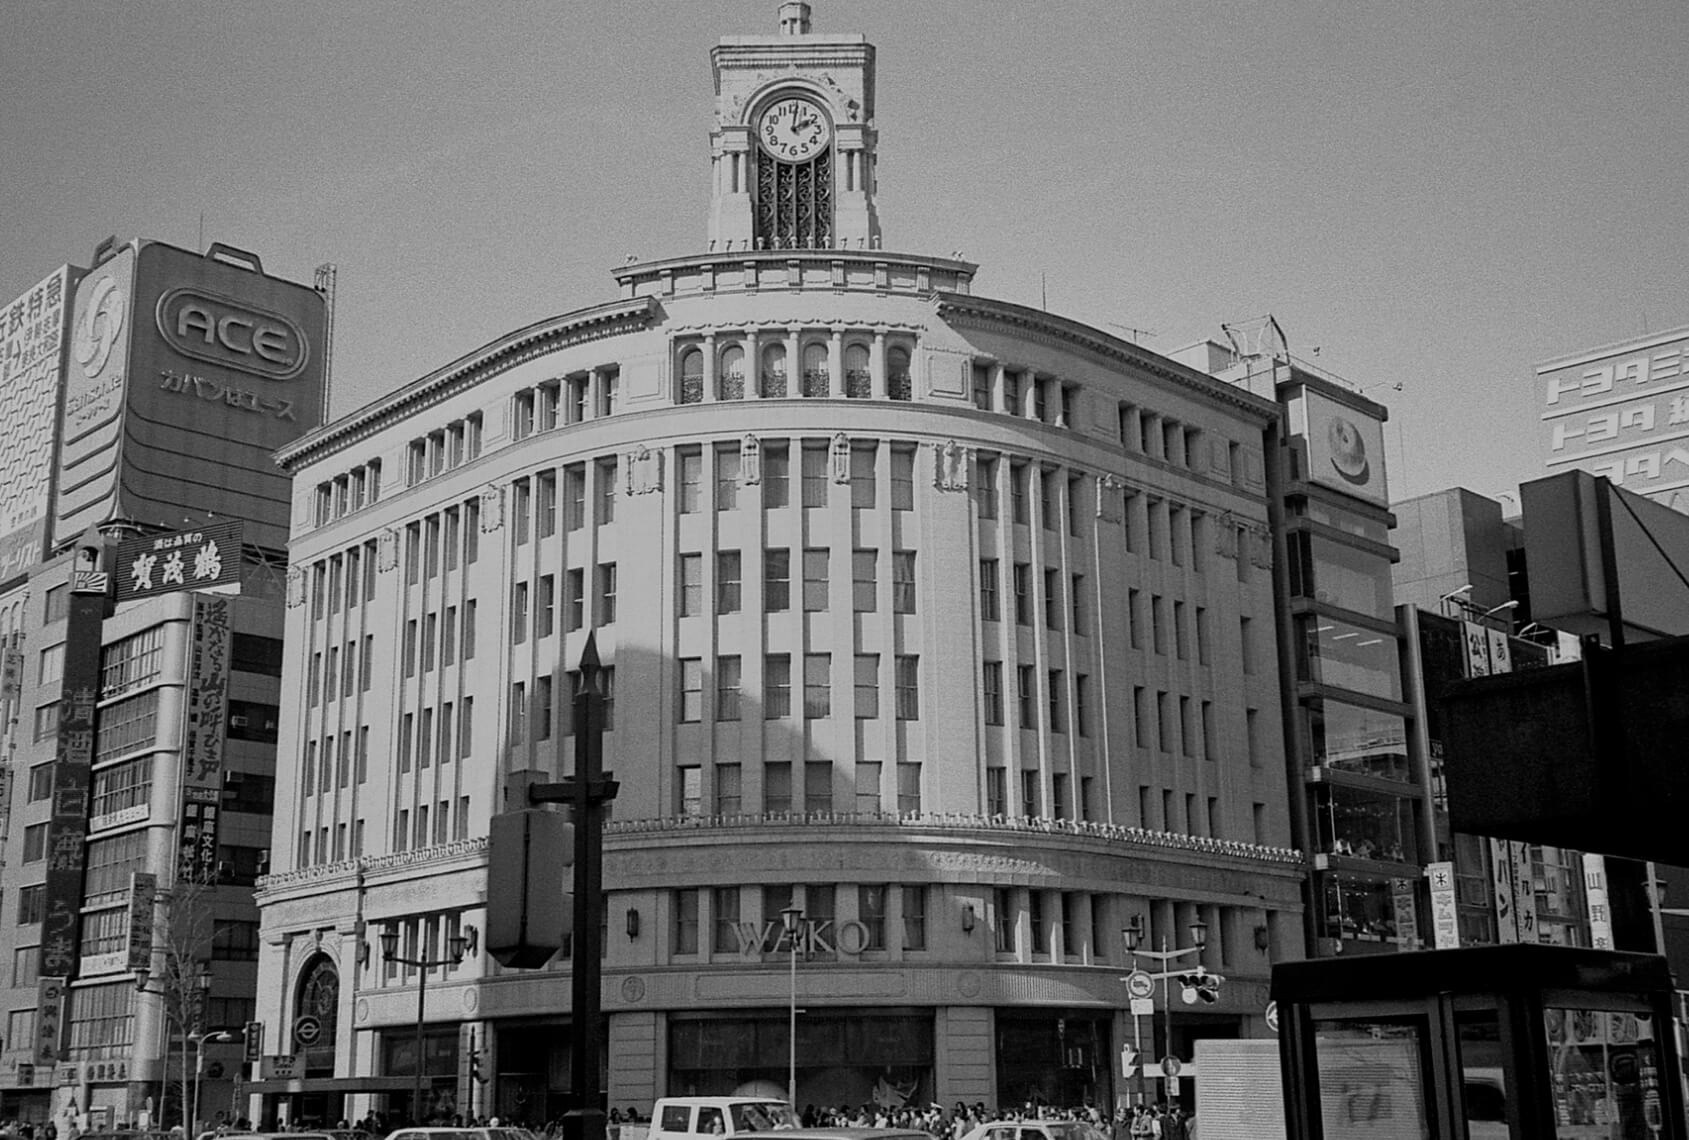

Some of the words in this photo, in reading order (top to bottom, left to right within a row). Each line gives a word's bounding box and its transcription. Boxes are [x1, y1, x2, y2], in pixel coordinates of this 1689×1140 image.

[769, 114, 779, 126] 10
[765, 125, 774, 136] 9
[814, 124, 822, 135] 3
[769, 135, 778, 146] 8
[809, 135, 818, 145] 4
[779, 143, 788, 153] 7
[789, 145, 798, 156] 6
[801, 143, 809, 153] 5
[178, 305, 287, 366] ACE
[131, 539, 222, 592] 賀茂鶴
[729, 919, 870, 956] WAKO
